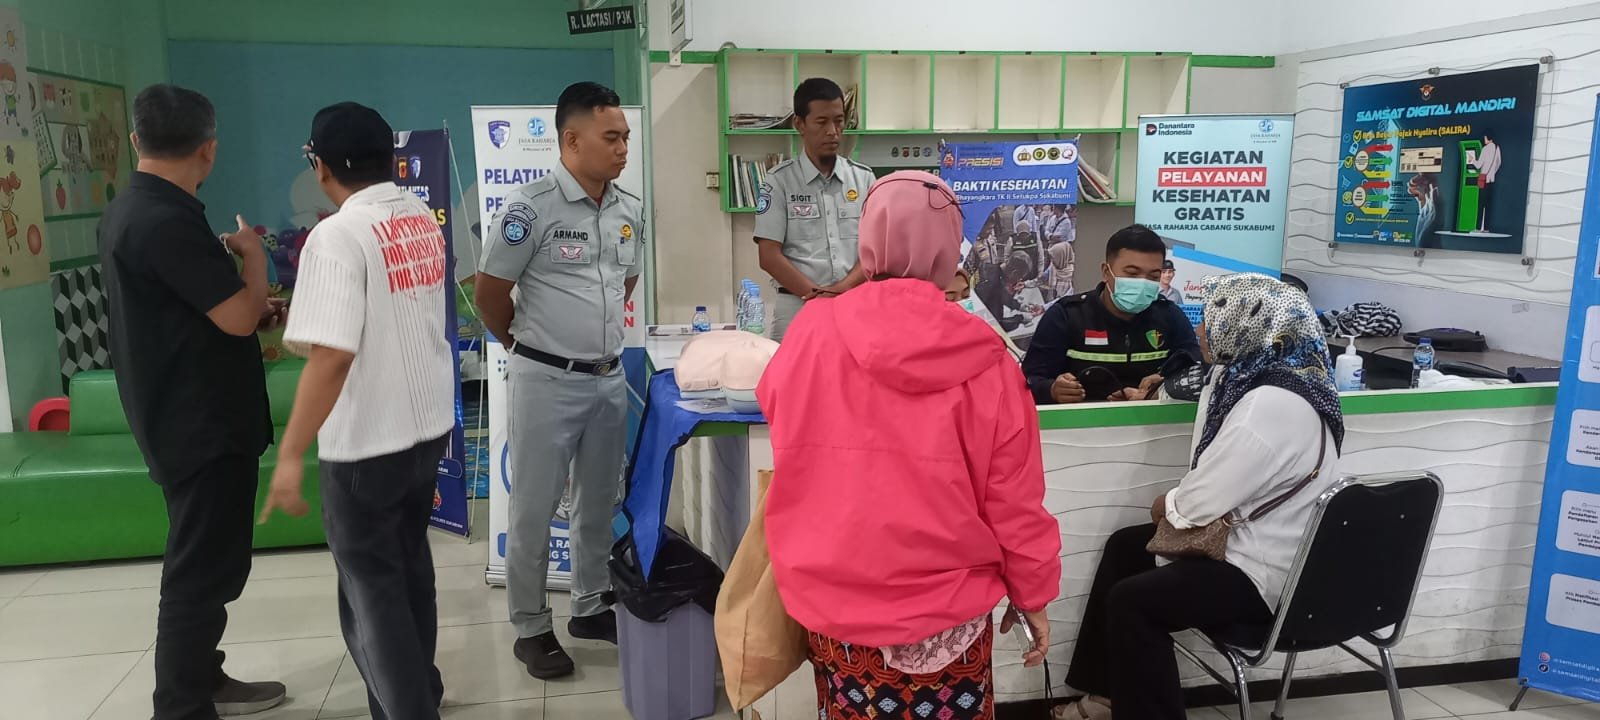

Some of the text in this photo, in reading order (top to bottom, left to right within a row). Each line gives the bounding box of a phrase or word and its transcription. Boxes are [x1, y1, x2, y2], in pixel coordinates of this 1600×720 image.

[570, 15, 580, 30] R.
[581, 12, 612, 28] LACTASI
[1356, 97, 1516, 122] SAMSAT DIGITAL MANDIRI
[1438, 125, 1471, 136] (SALIRA)
[958, 157, 1004, 167] PRESISI
[1164, 151, 1263, 164] KEGIATAN
[1161, 171, 1263, 183] PELAYANAN
[953, 179, 1067, 192] BAKTI KESEHATAN
[1152, 189, 1270, 203] KESEHATAN
[1174, 208, 1245, 220] GRATIS
[553, 230, 588, 240] ARMAND
